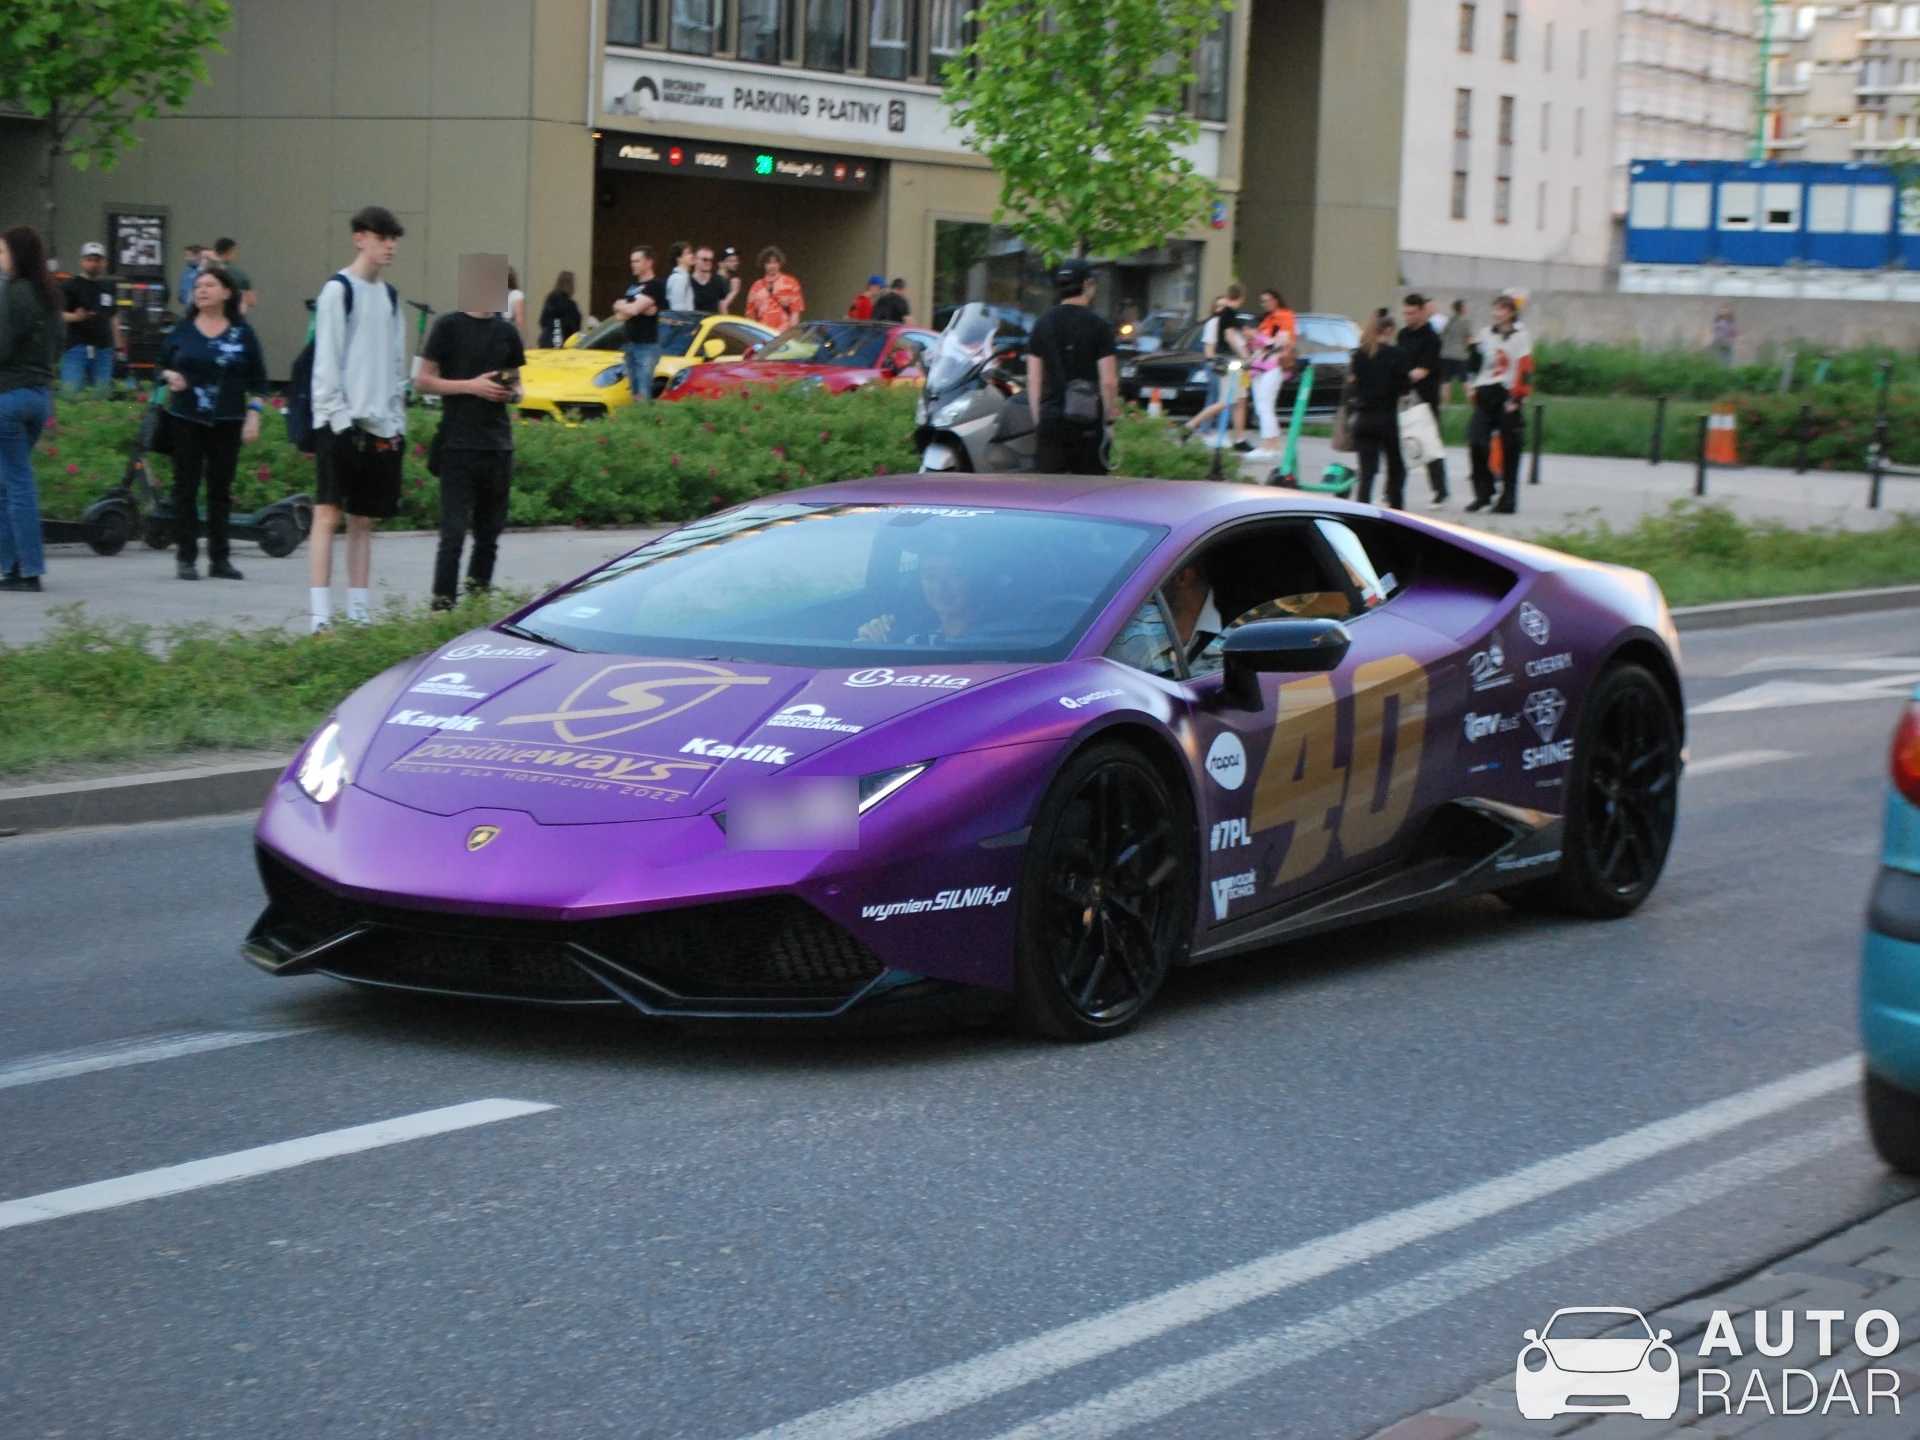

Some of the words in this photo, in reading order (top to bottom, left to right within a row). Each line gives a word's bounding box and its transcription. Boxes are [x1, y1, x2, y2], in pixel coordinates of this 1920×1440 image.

[733, 87, 811, 116] PARKING
[817, 97, 882, 125] PŁATNY
[386, 709, 485, 732] Karlik
[400, 742, 711, 780] positiveways
[679, 738, 795, 765] Karlik
[1522, 738, 1574, 770] SHINE
[1250, 654, 1430, 888] 40
[618, 786, 681, 803] 2022
[861, 885, 1012, 922] wymienSILNIK.pl
